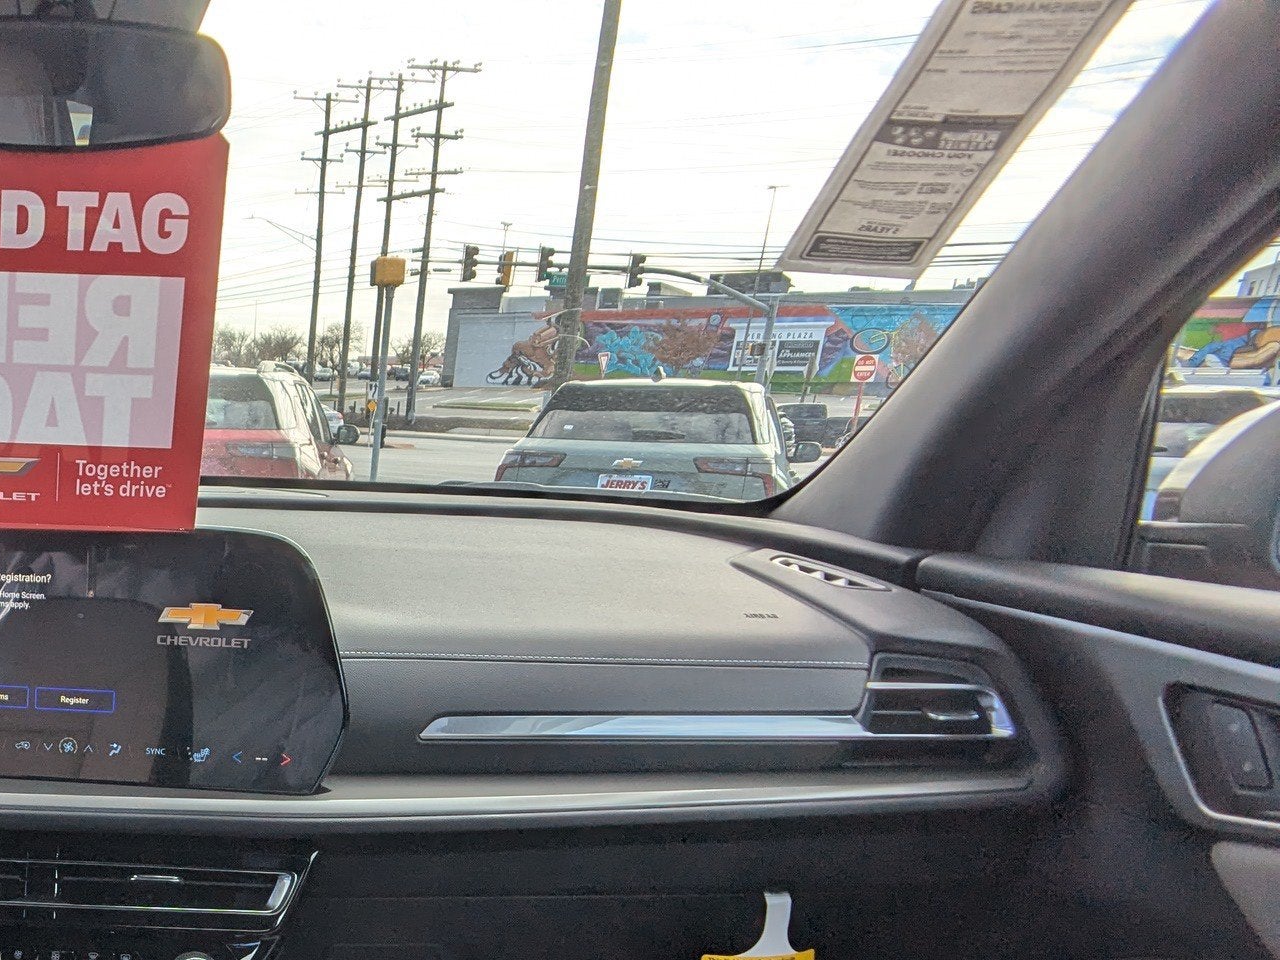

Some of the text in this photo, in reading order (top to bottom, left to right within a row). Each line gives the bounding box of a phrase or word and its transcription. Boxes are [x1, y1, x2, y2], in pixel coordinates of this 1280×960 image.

[56, 190, 190, 255] TAG
[746, 332, 783, 340] PERNG
[75, 460, 163, 479] Together
[75, 480, 167, 499] let's drive
[601, 479, 648, 490] JERRY'S
[0, 590, 20, 599] Home
[21, 592, 46, 600] Screen.
[9, 601, 31, 610] apply.
[156, 634, 251, 650] CHEVROLET
[60, 696, 90, 706] Register
[146, 747, 166, 756] SYNC
